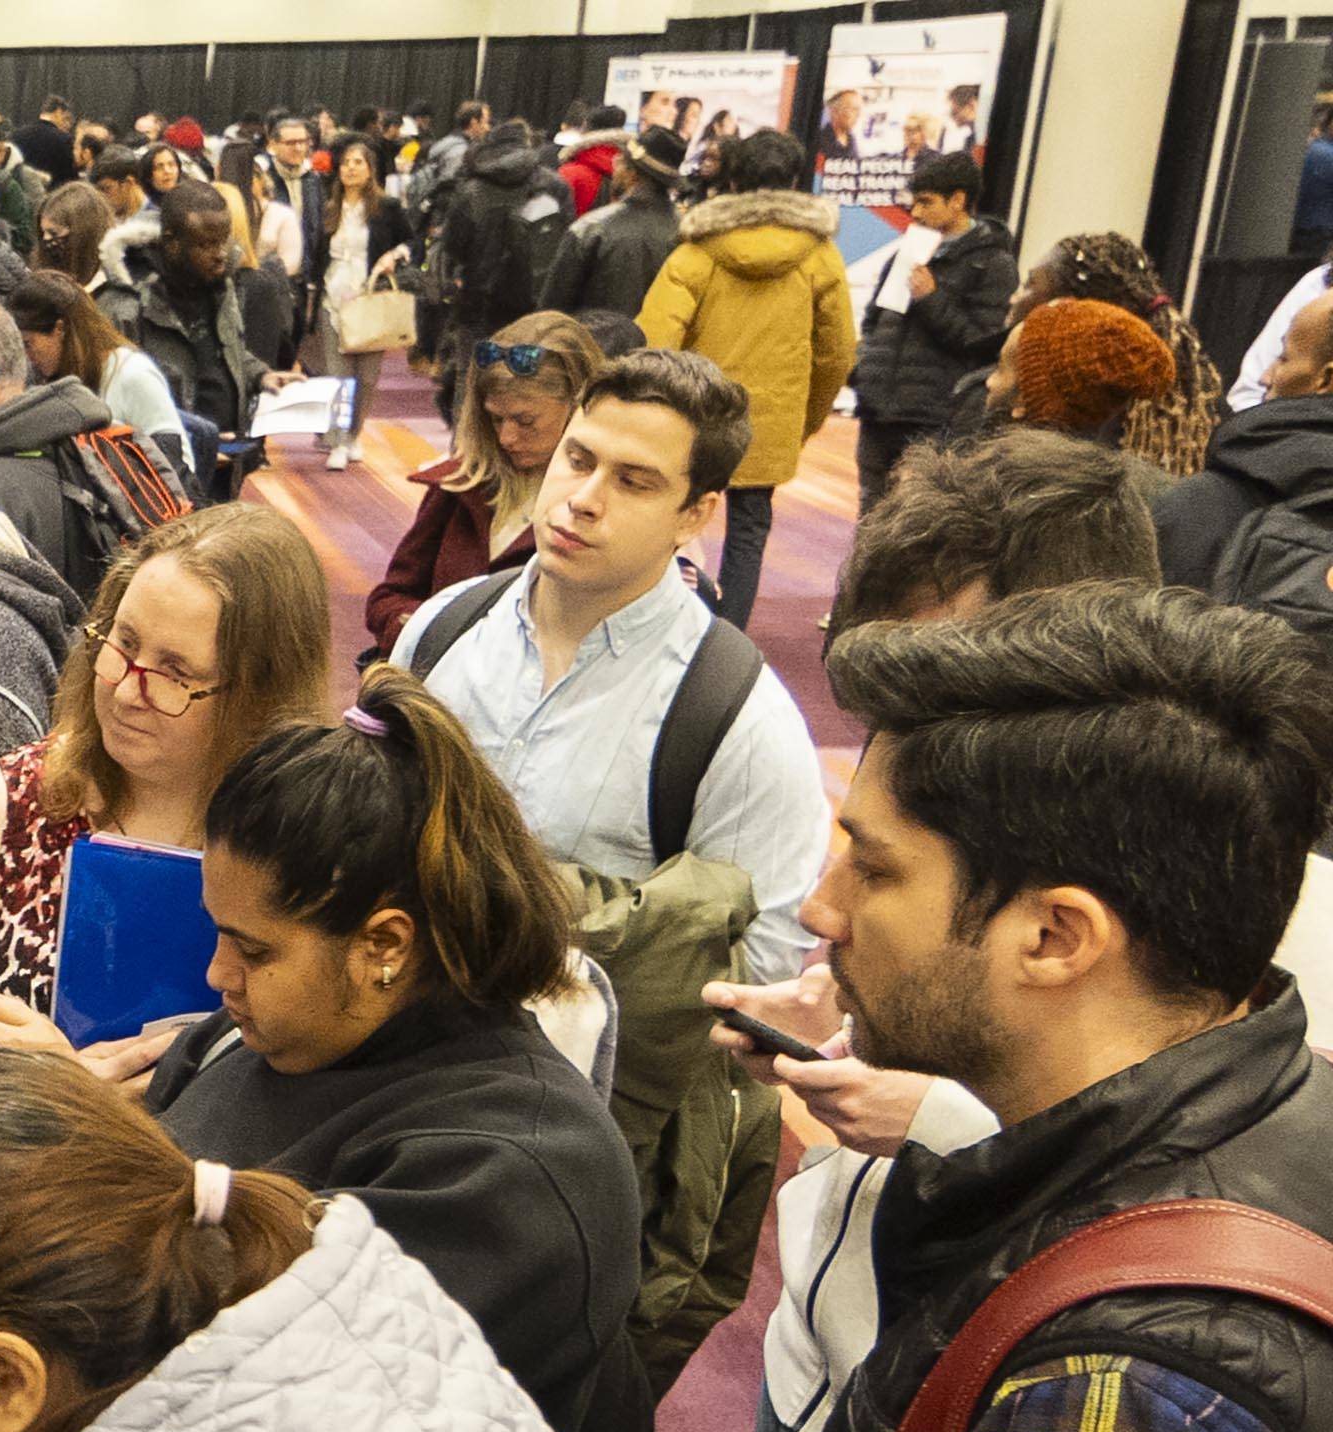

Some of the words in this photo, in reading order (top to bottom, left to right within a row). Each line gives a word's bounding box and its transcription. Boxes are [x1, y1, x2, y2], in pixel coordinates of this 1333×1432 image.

[824, 157, 857, 175] REAL
[860, 157, 915, 175] PEOPLE
[822, 174, 856, 191] REAL
